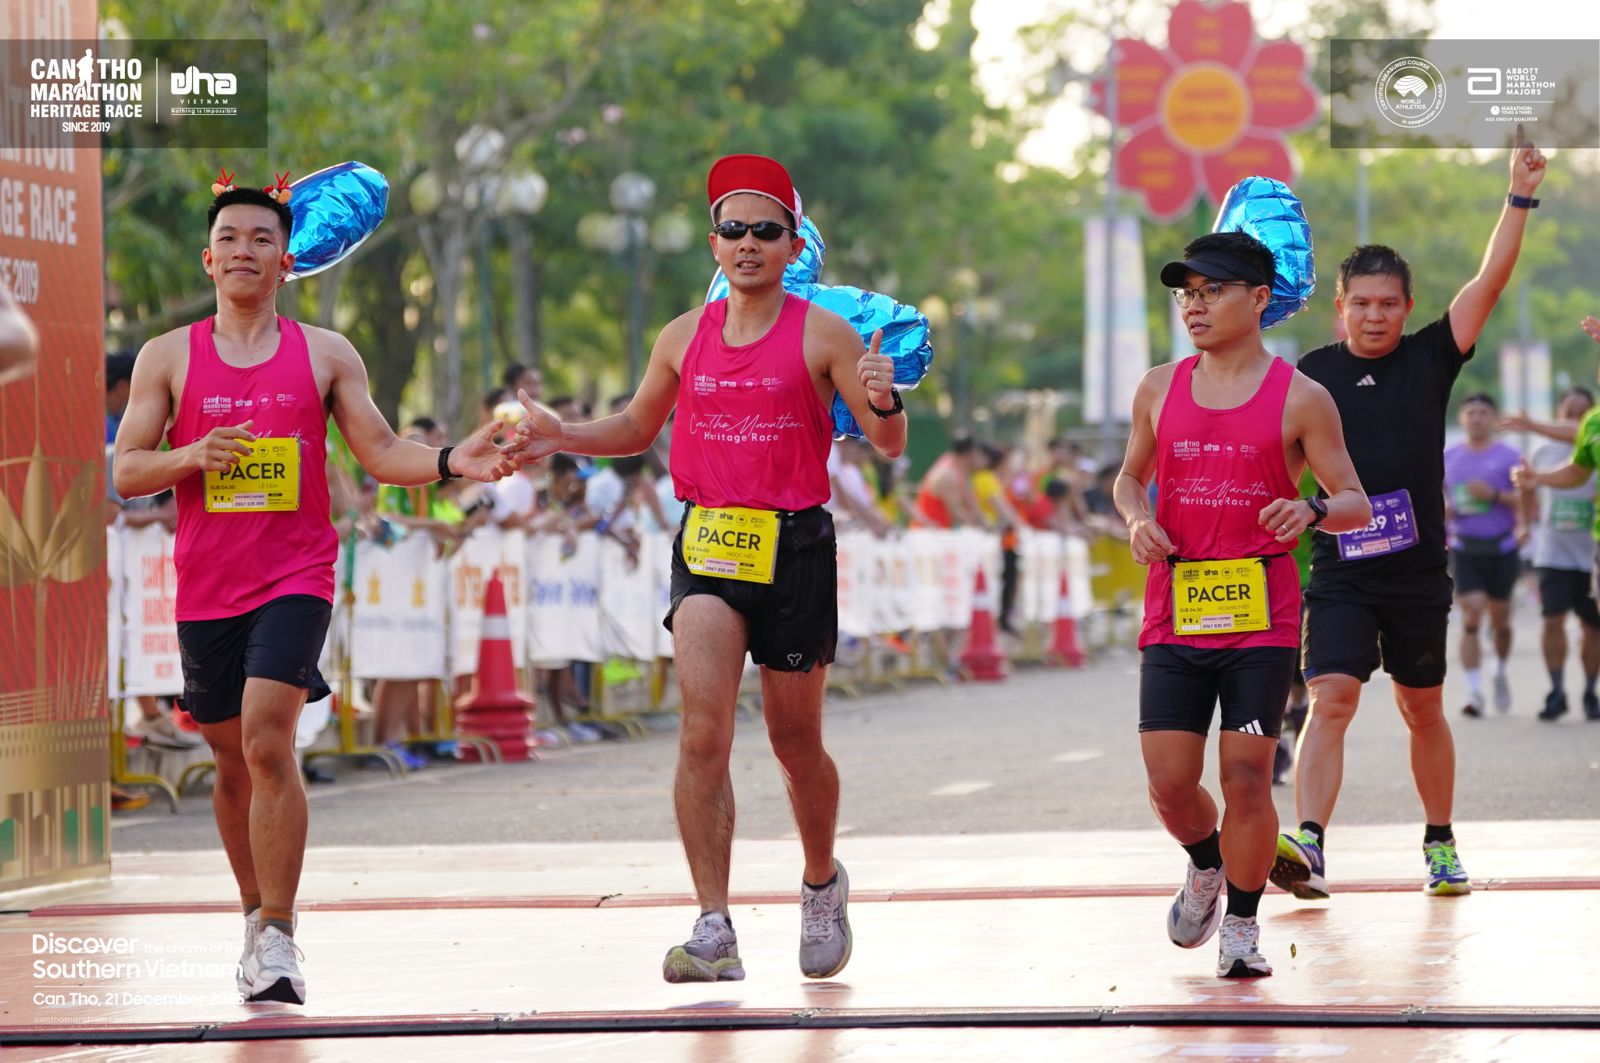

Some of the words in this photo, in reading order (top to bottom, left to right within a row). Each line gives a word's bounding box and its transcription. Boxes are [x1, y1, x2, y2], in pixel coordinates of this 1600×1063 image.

[0, 176, 25, 239] GE
[29, 182, 78, 247] RACE
[12, 258, 39, 305] 2019
[724, 412, 805, 437] Marathon
[703, 431, 748, 444] Heritage
[751, 432, 779, 442] Race
[220, 463, 286, 480] PACER
[1179, 496, 1224, 508] Heritage
[1225, 497, 1251, 507] Race
[1394, 511, 1407, 524] M
[697, 526, 762, 551] PACER
[1187, 583, 1252, 603] PACER
